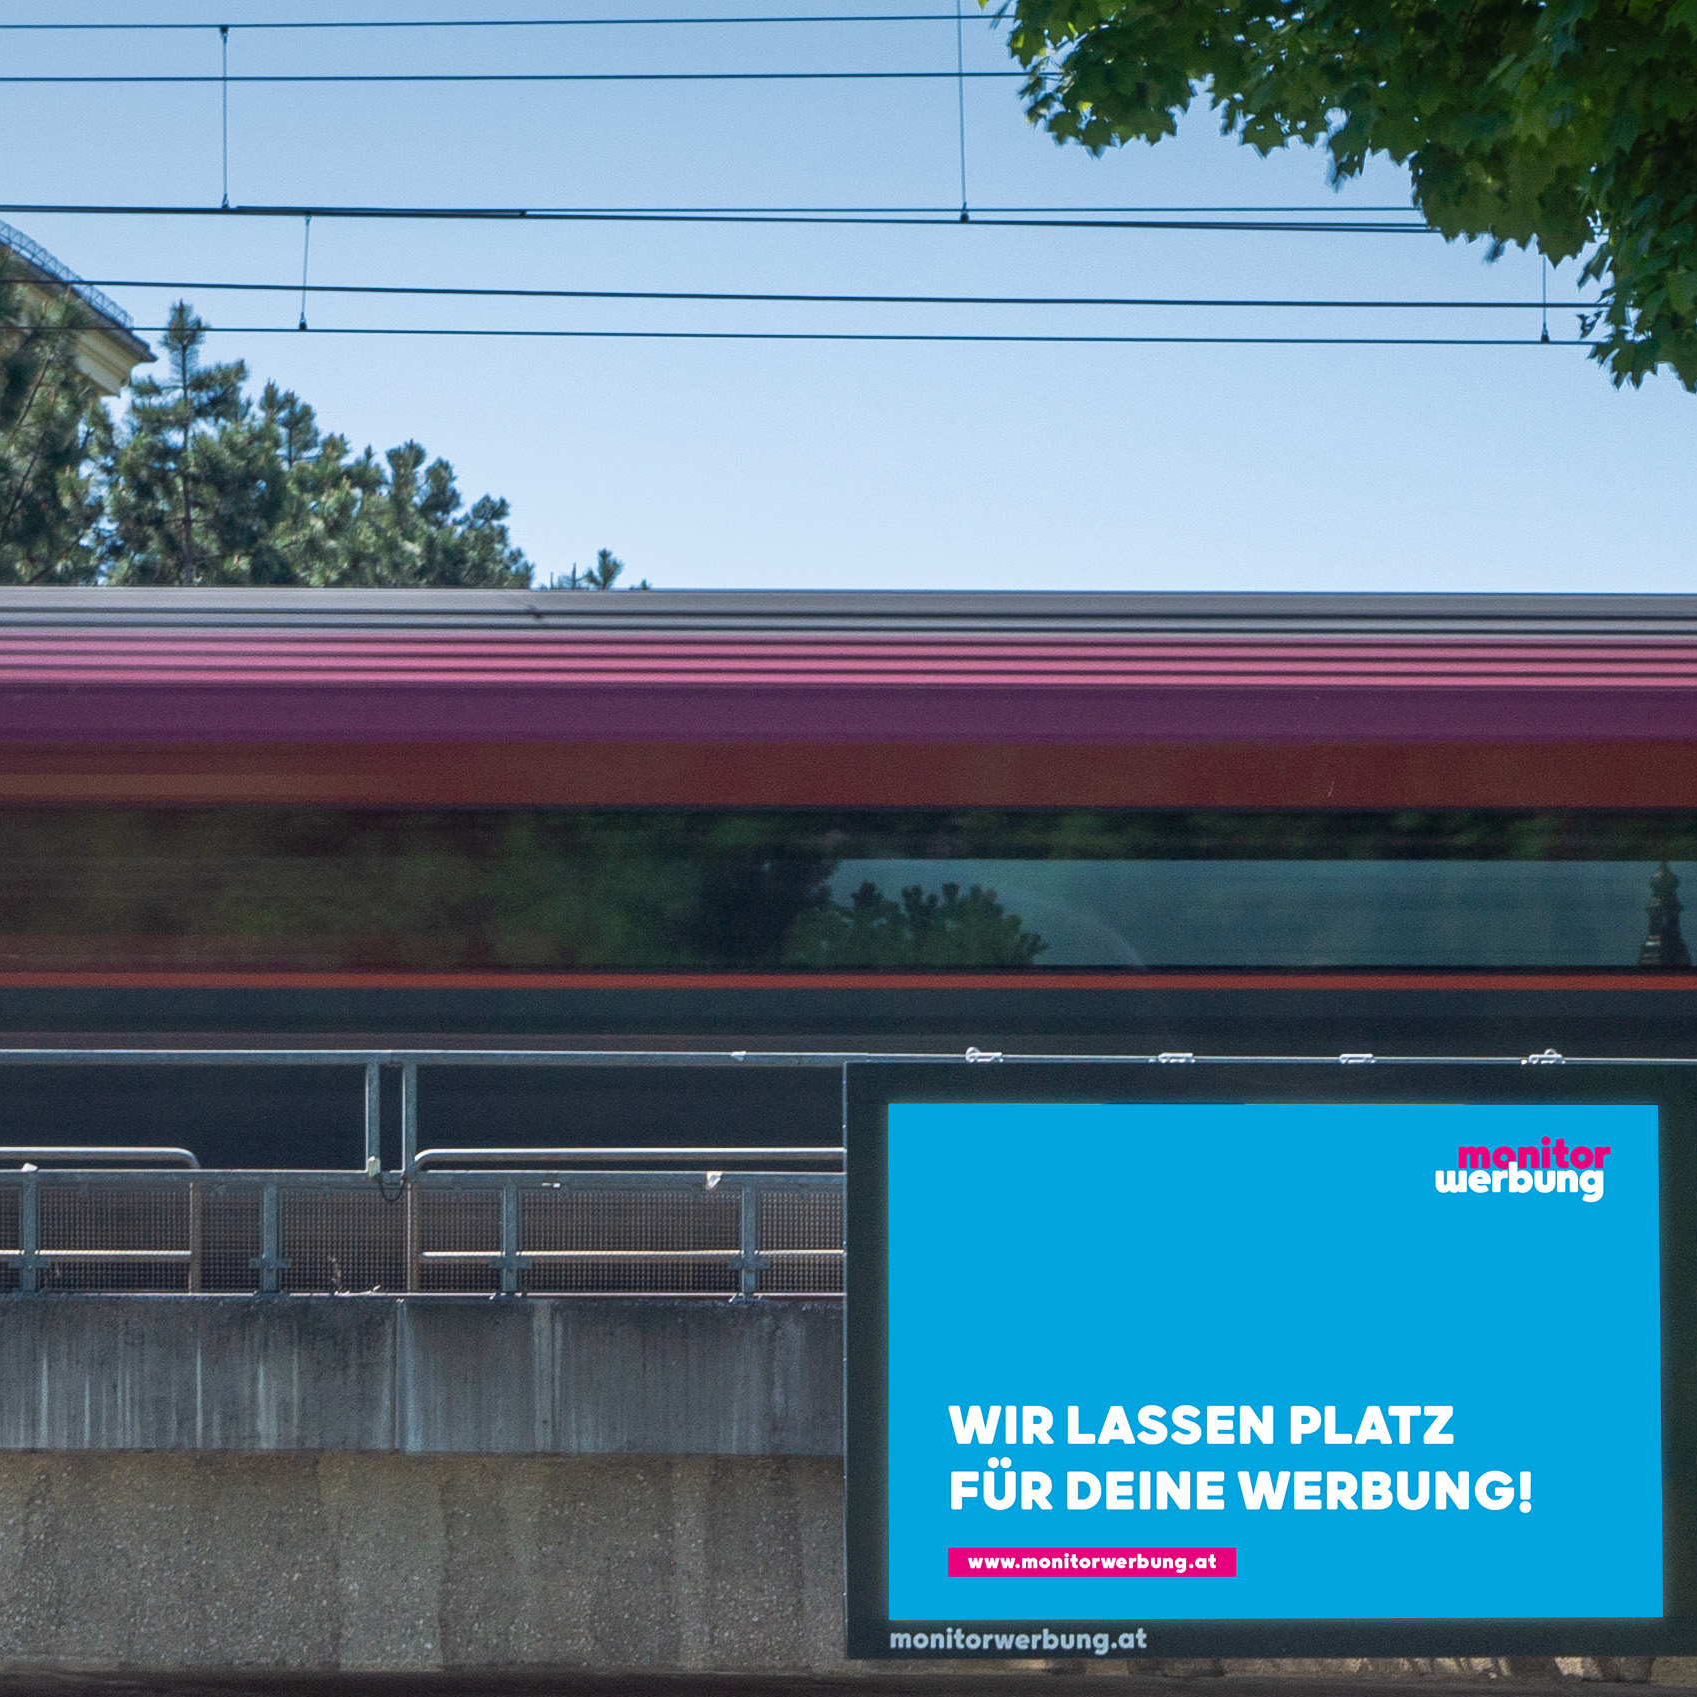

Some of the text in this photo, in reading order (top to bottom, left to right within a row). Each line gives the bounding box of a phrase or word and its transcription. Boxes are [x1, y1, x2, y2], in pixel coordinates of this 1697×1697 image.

[1458, 1136, 1611, 1170] monitor
[1435, 1161, 1604, 1203] werbung
[948, 1405, 1454, 1445] WIR LASSEN PLATZ
[950, 1457, 1532, 1514] FÜR DEINE WERBUNG!
[967, 1552, 1217, 1574] www.monitorwerbung.at
[890, 1627, 1147, 1655] monitorwerbung.at
